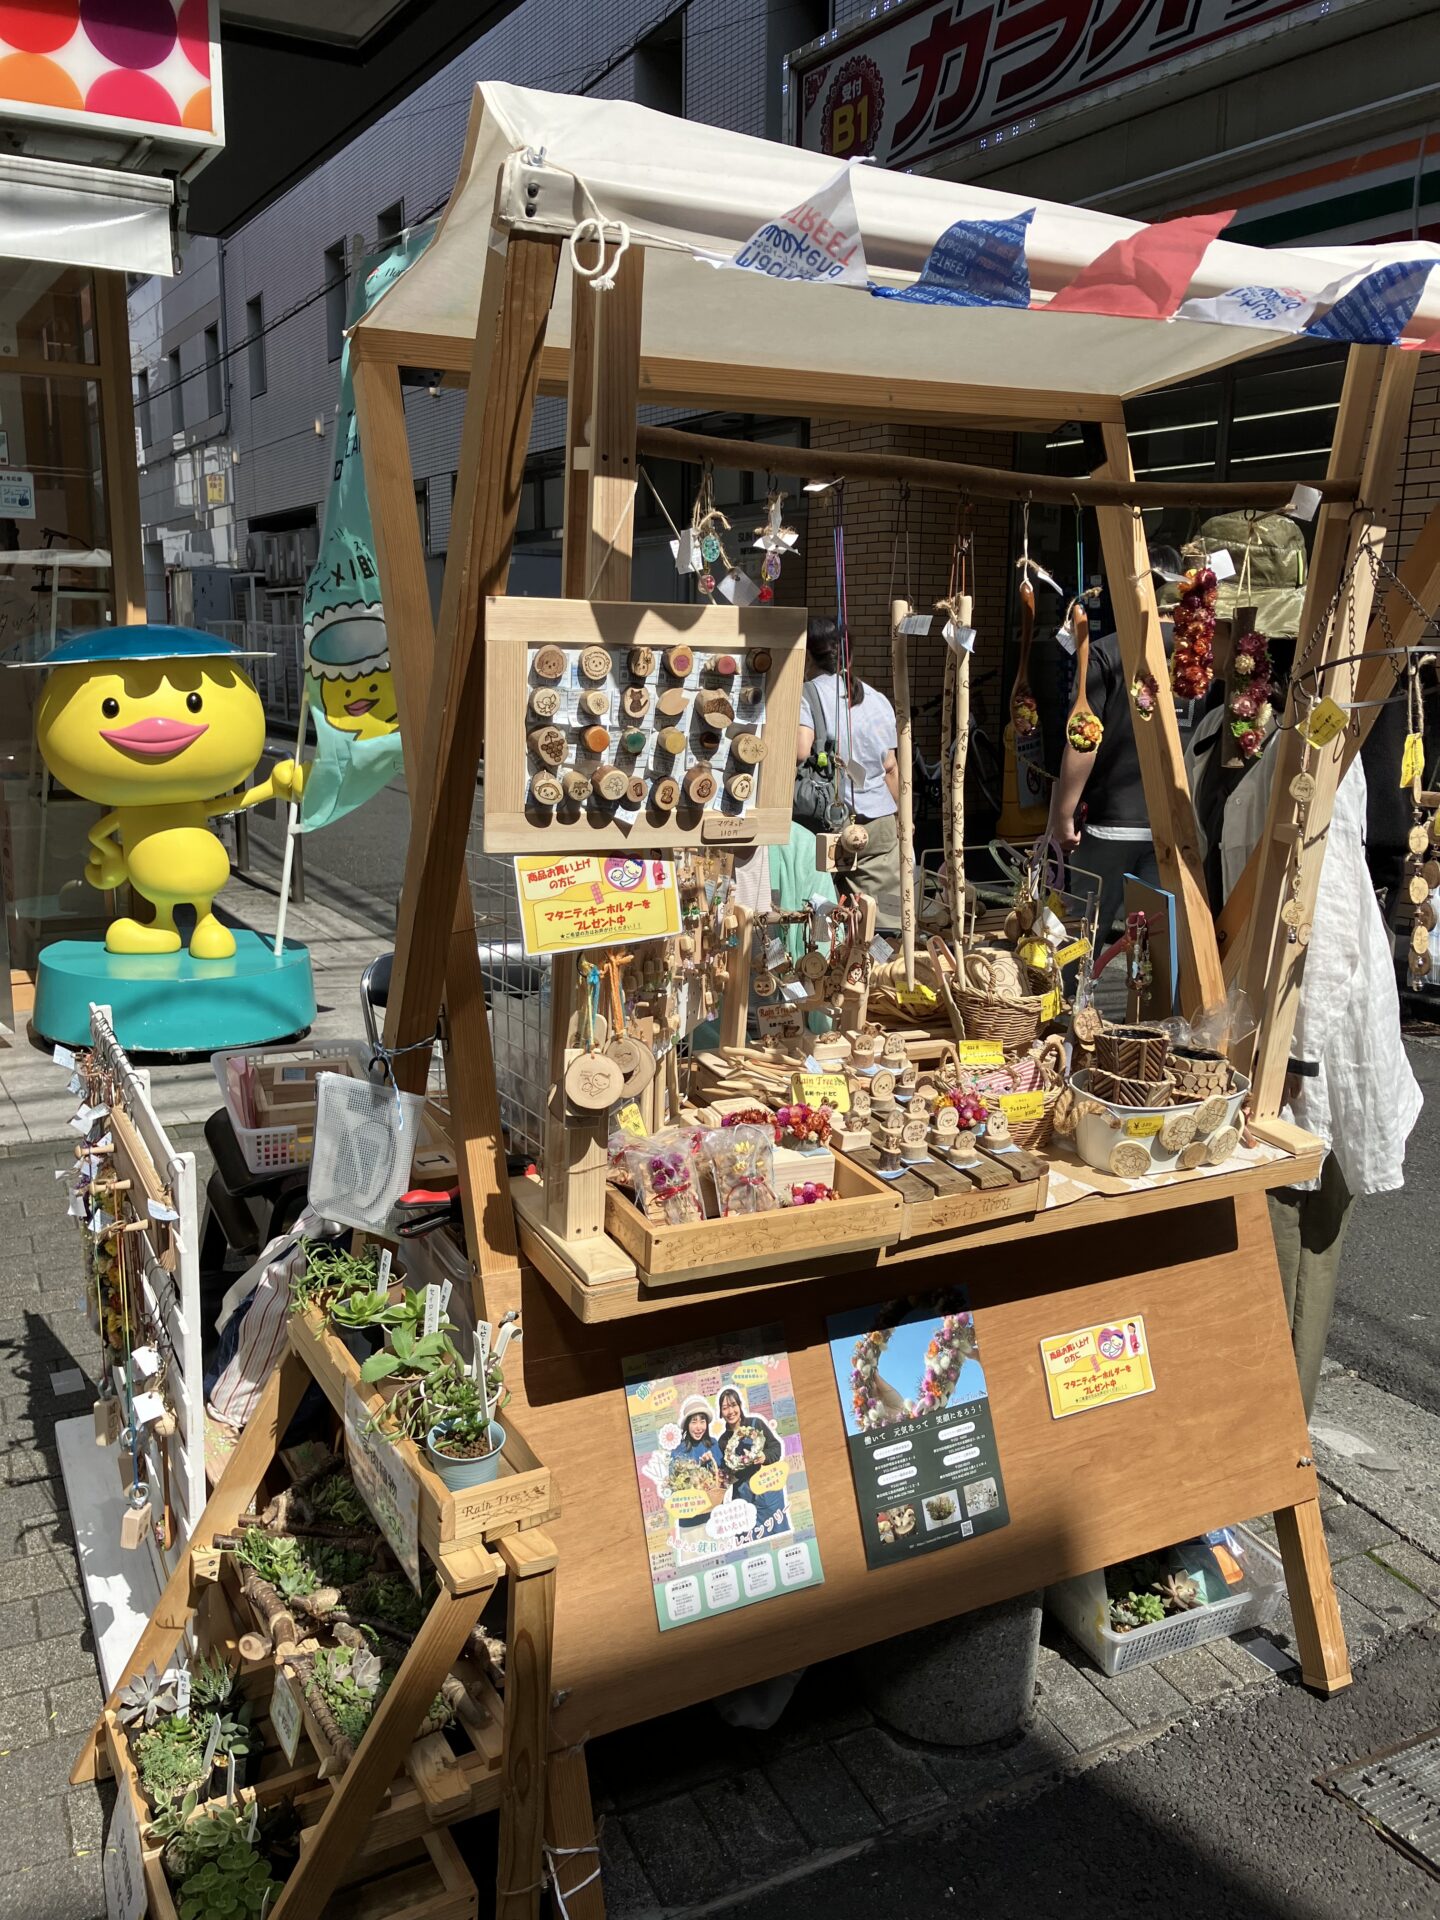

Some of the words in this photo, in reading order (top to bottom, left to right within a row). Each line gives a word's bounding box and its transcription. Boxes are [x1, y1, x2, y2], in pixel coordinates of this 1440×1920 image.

[841, 82, 862, 103] 受付
[833, 96, 868, 150] B1
[716, 818, 745, 828] マグネット
[527, 858, 592, 883] 商品お買い上げ
[549, 875, 577, 890] の方に
[544, 899, 651, 922] マタニティキーホルダーを
[574, 915, 626, 931] プレゼント中
[795, 1077, 814, 1085] Rain
[815, 1076, 833, 1085] Tree
[1049, 1336, 1090, 1360] 商品お買い上げ
[1064, 1351, 1081, 1365] の方に
[1063, 1365, 1132, 1391] マタニティキーホルダーを
[1083, 1379, 1117, 1395] プレゼント中
[864, 1431, 887, 1446] 働いて
[462, 1503, 493, 1519] Rain
[496, 1491, 523, 1507] Tree
